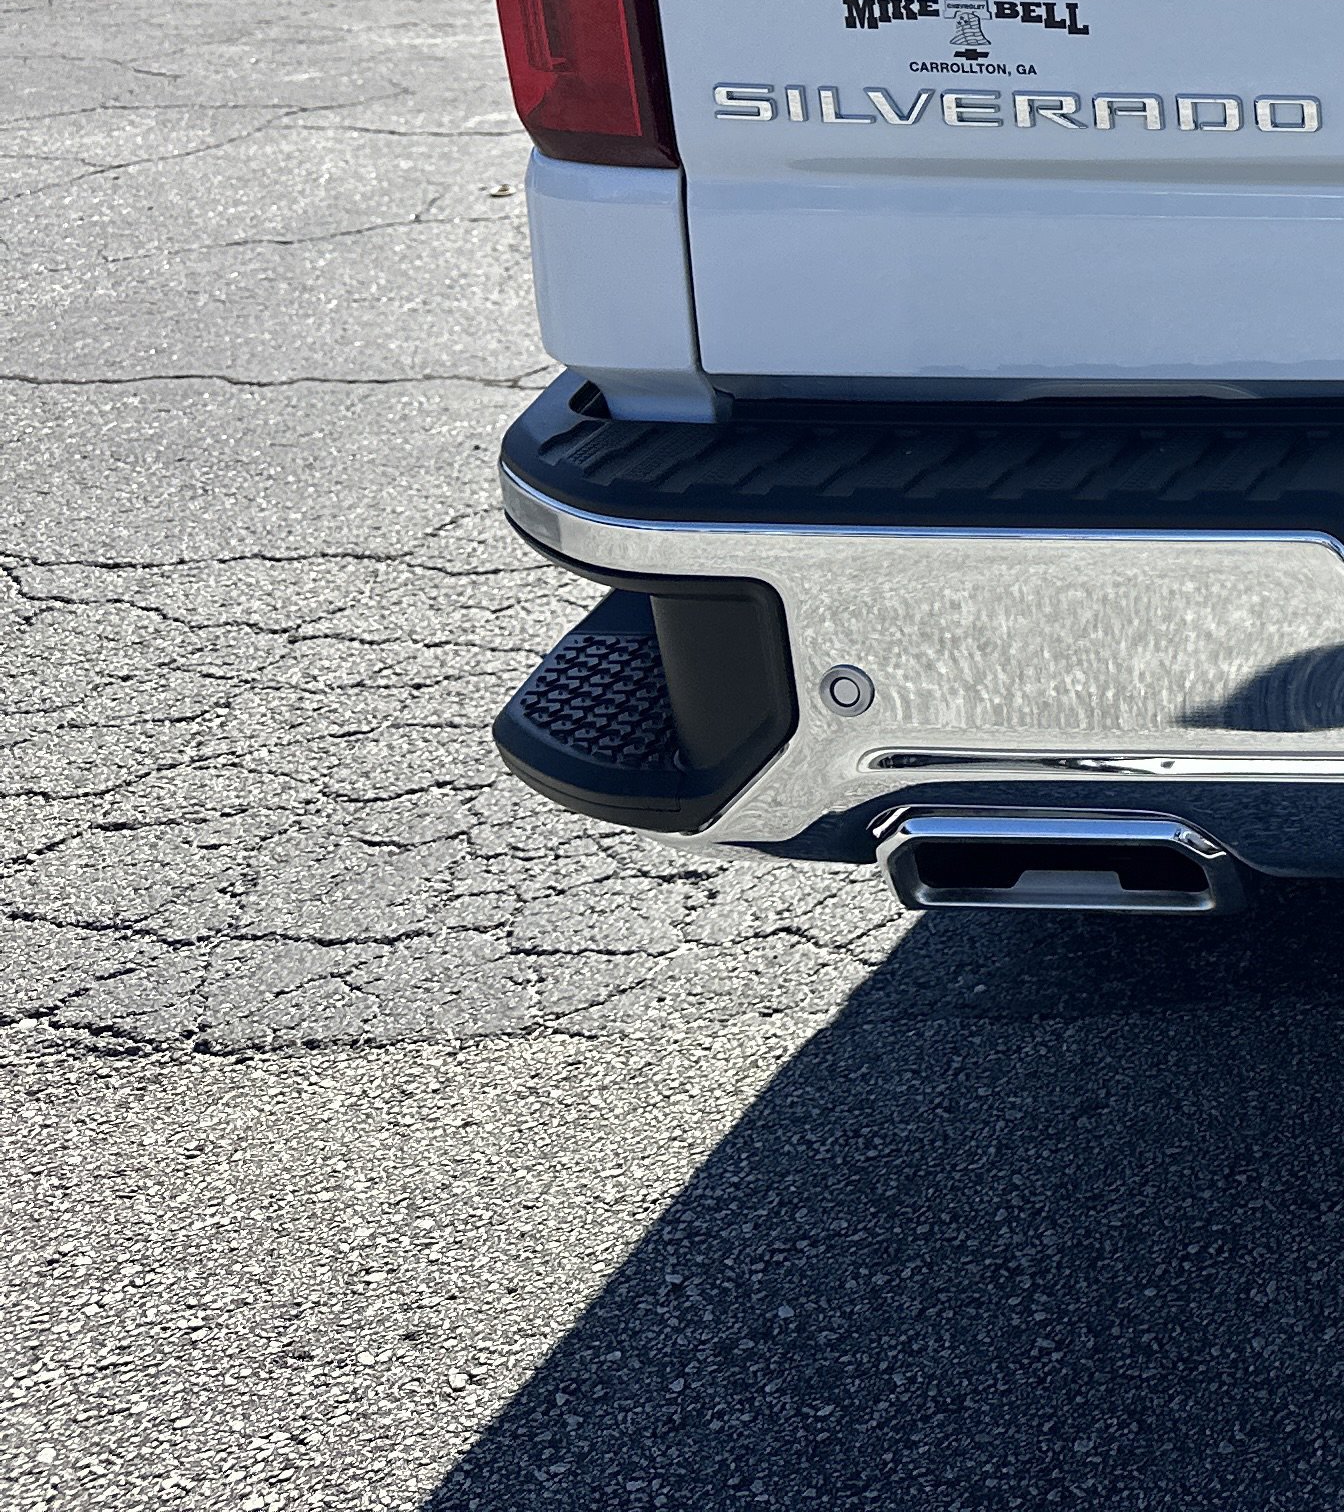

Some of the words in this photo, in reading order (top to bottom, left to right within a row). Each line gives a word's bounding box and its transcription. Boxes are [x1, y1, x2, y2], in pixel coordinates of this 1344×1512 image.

[993, 0, 1090, 35] BELL
[909, 61, 1012, 76] CARROLLTON,
[1016, 64, 1037, 75] GA
[713, 82, 1323, 133] SILVERADO
